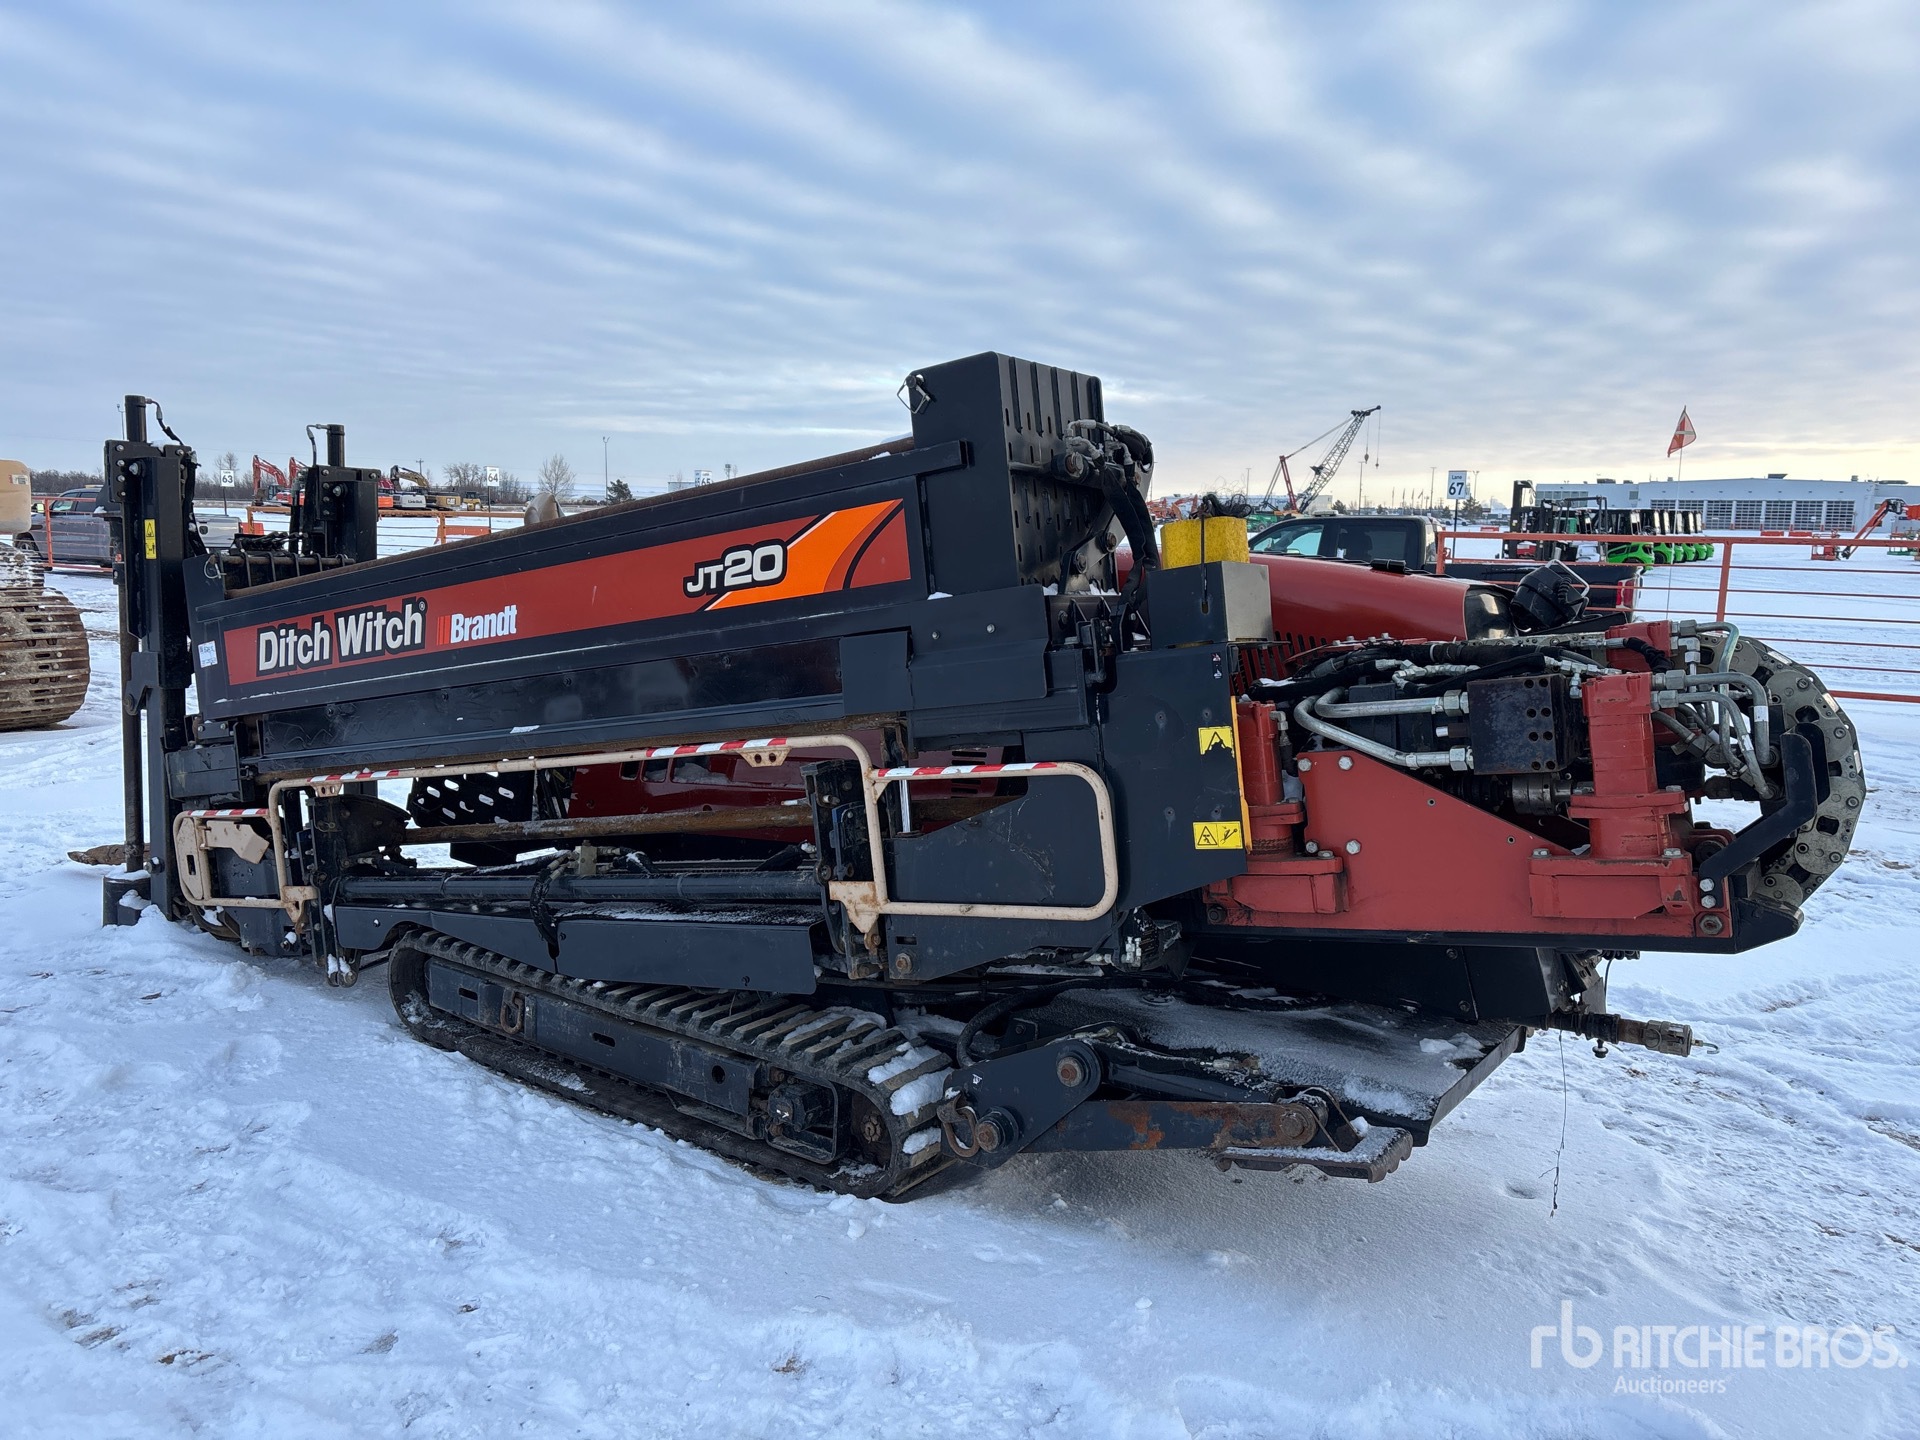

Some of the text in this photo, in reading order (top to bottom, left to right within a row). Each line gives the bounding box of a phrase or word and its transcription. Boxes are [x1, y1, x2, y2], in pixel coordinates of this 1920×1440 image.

[222, 474, 234, 484] 63
[488, 473, 499, 483] 64
[1449, 482, 1464, 495] 67
[686, 544, 784, 593] JT20
[450, 604, 518, 644] Brandt
[259, 621, 331, 672] Ditch
